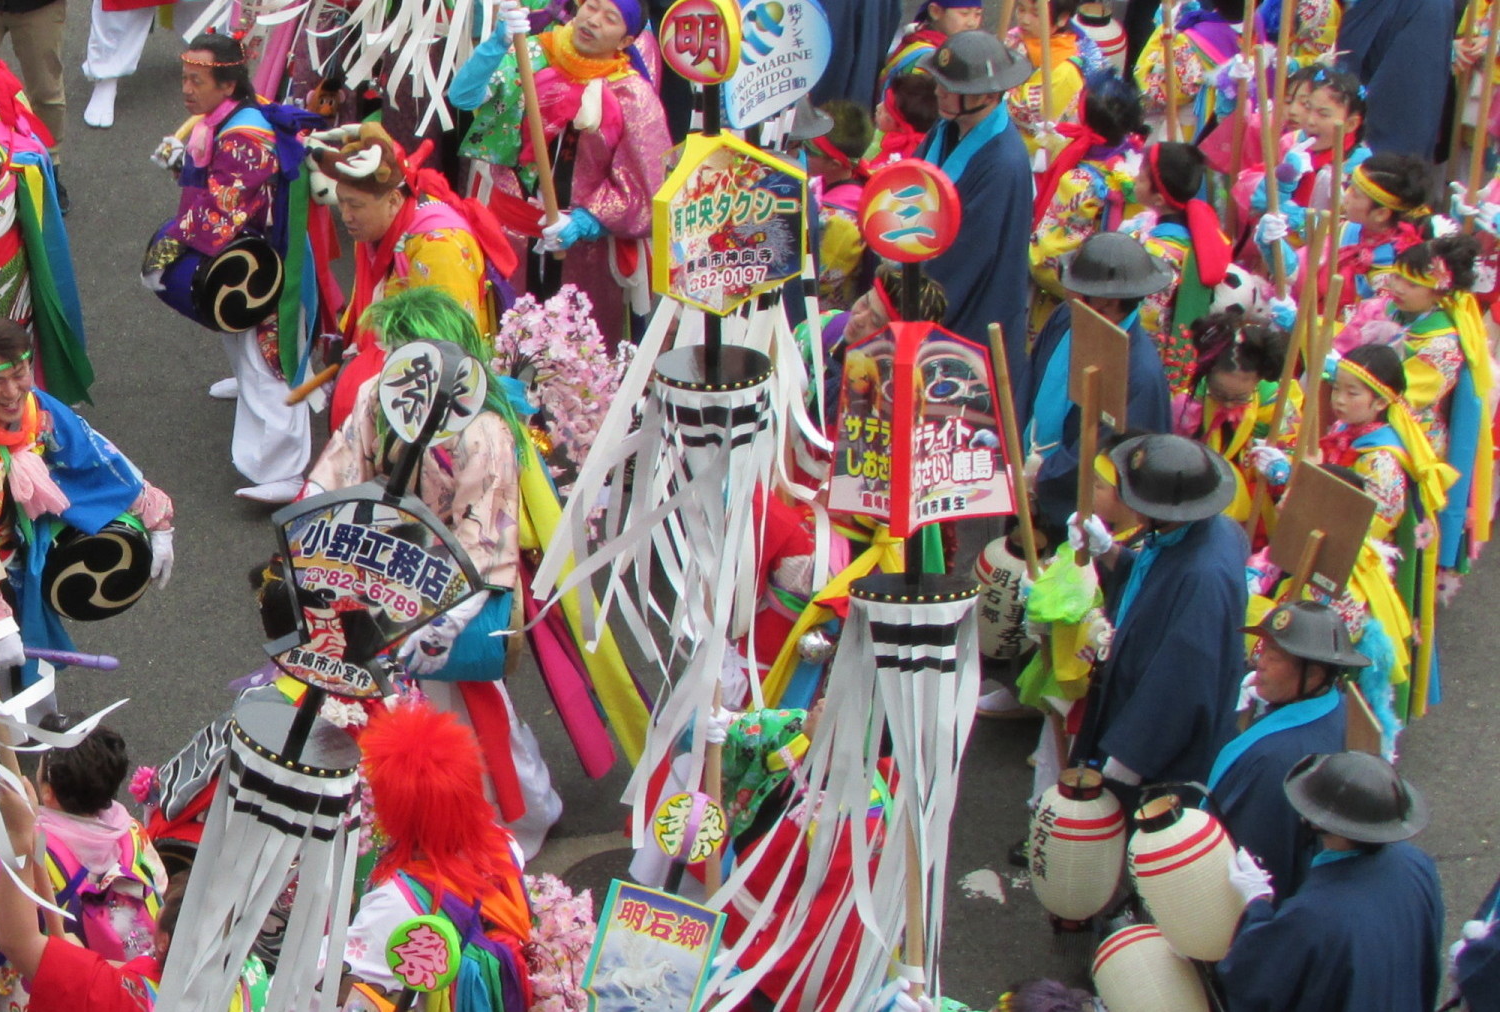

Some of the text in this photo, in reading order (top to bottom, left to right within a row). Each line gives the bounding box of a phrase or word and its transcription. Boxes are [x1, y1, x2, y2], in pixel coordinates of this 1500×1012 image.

[673, 13, 724, 75] 明
[756, 49, 813, 80] MARINE
[738, 77, 807, 121] 東京海上日動
[739, 67, 793, 102] NICHIDO
[879, 184, 936, 243] 三
[700, 267, 767, 290] 82-0197
[301, 519, 452, 604] 小野工務店
[326, 569, 419, 618] 82-6789
[285, 649, 371, 690] 鹿嶋市小宮作
[617, 899, 709, 950] 明石郷
